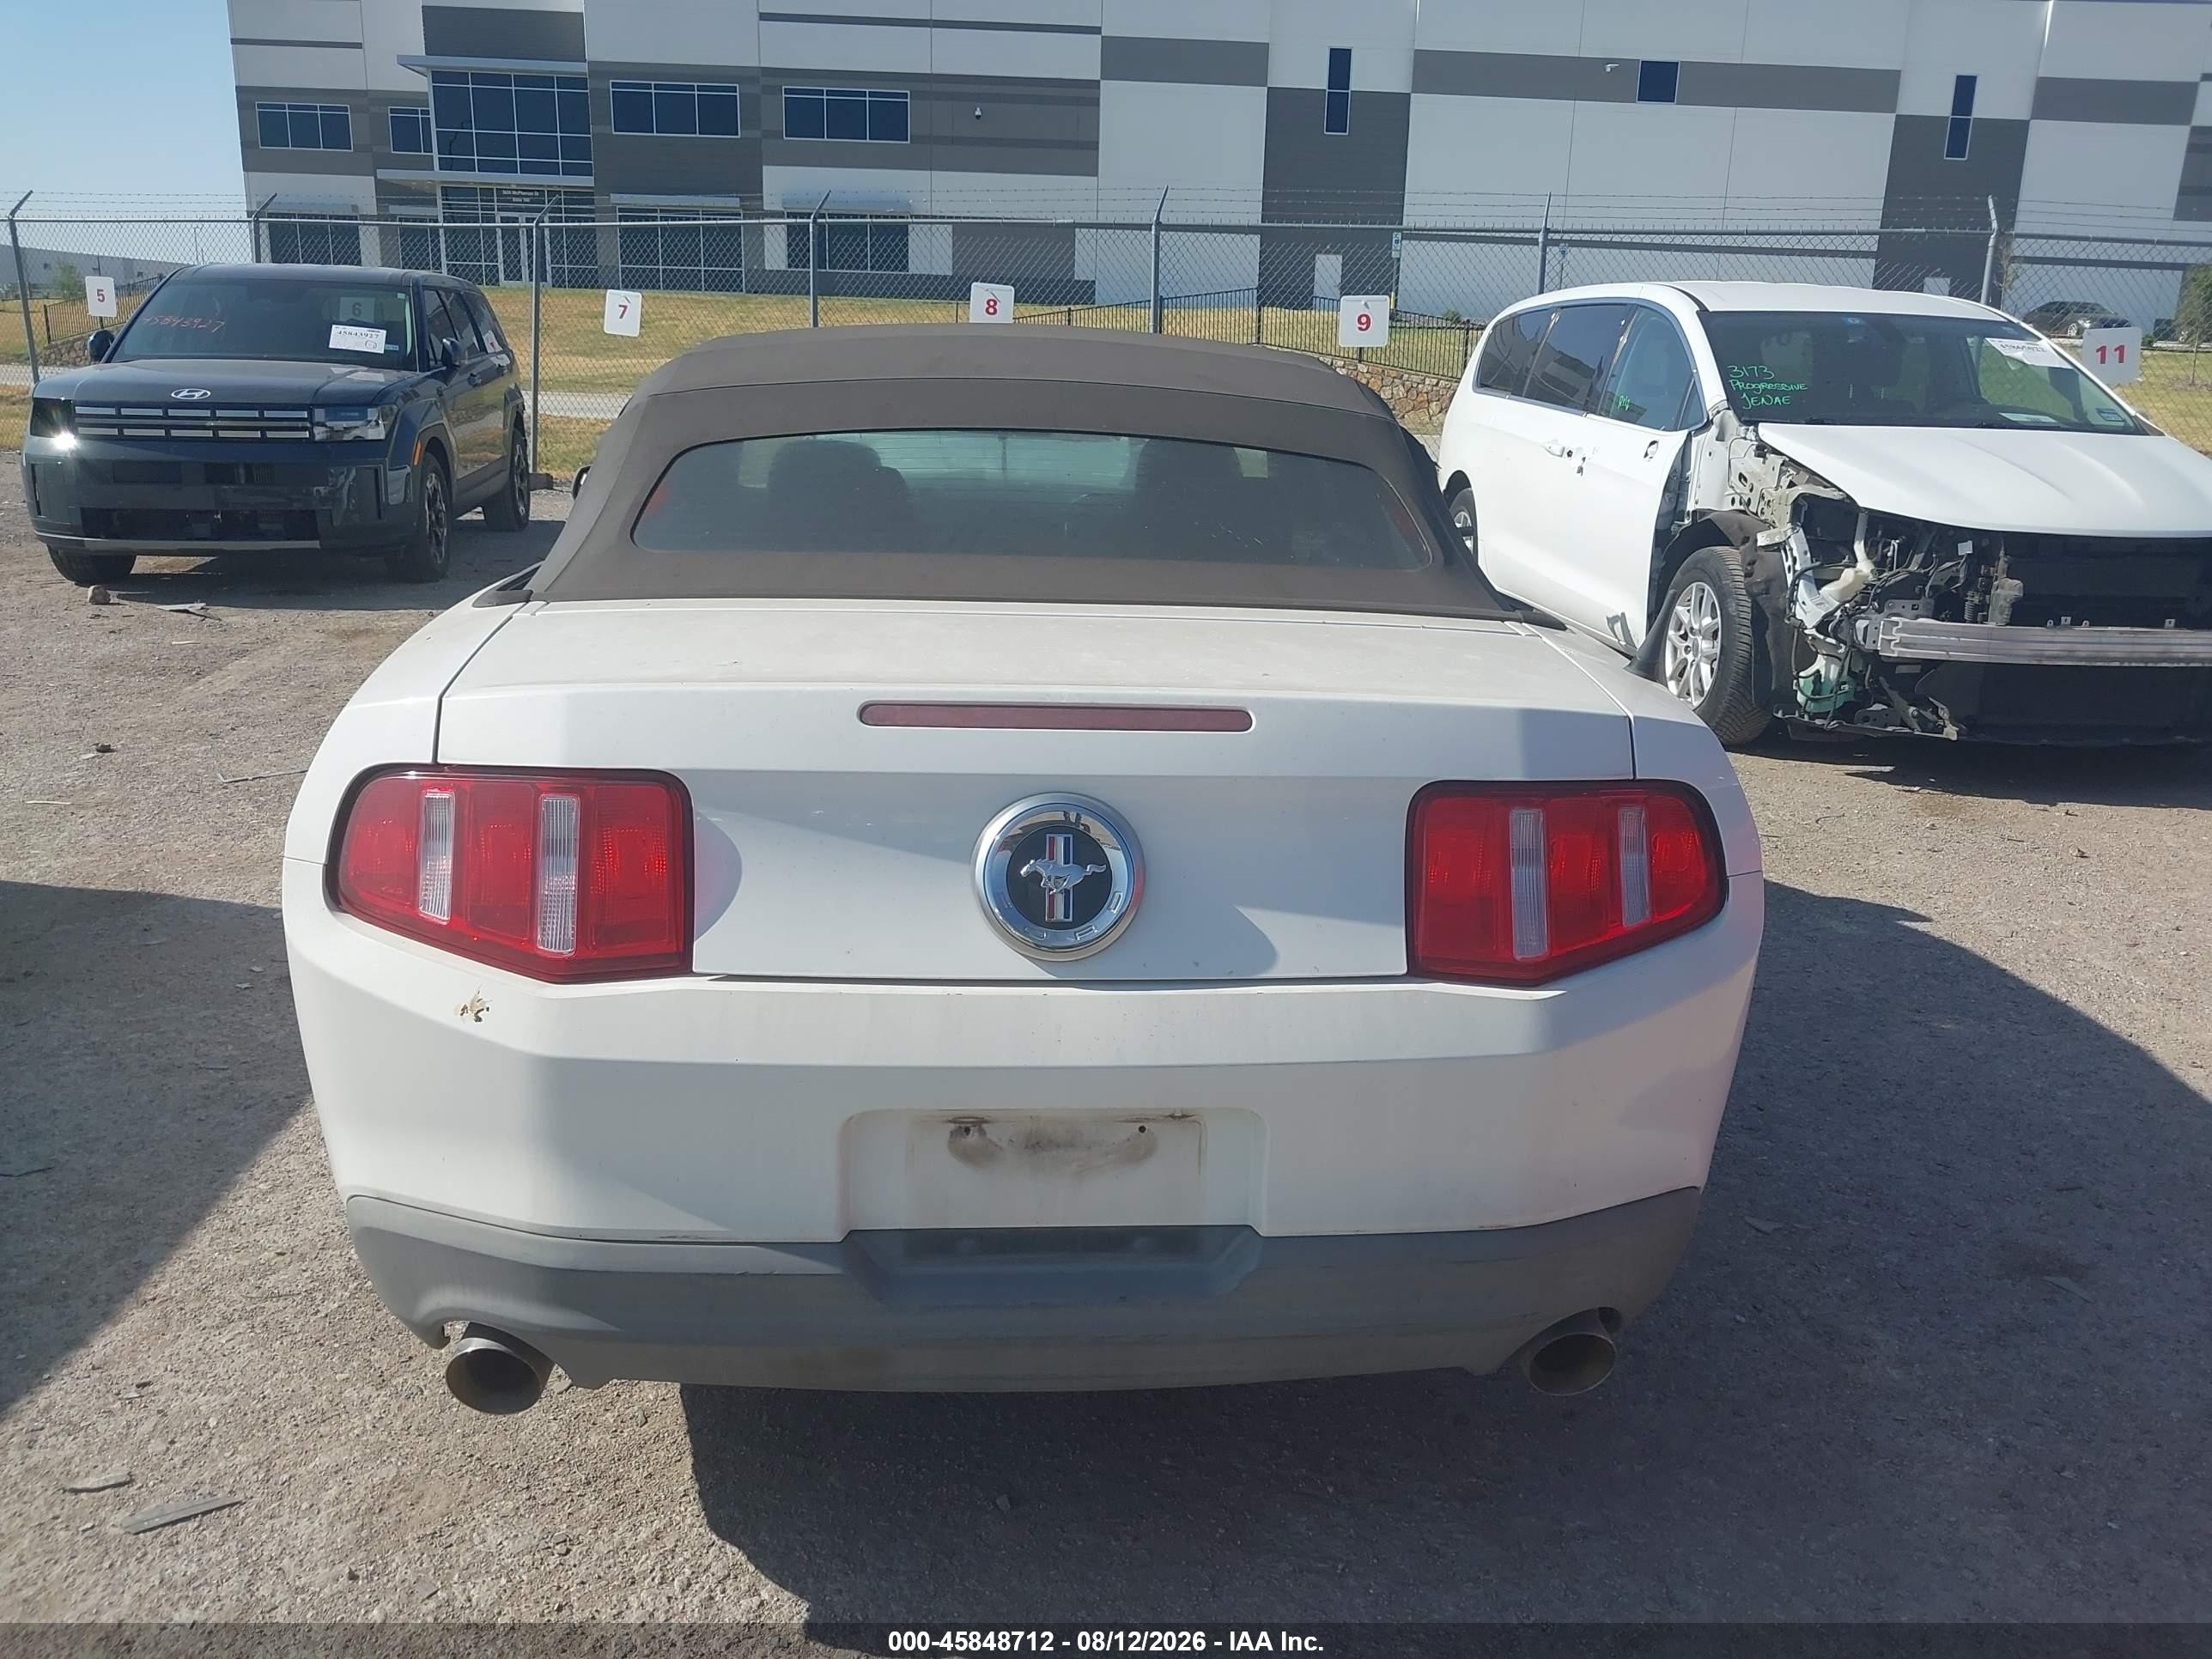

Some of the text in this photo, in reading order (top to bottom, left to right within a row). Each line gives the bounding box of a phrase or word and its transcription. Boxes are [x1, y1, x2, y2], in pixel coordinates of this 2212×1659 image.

[96, 289, 106, 302] 5
[351, 302, 362, 317] 6
[618, 304, 628, 319] 7
[985, 299, 998, 315] 8
[1357, 313, 1371, 331] 9
[2096, 344, 2125, 365] 11
[1727, 365, 1775, 380] 3173
[1741, 392, 1791, 410] JENAE
